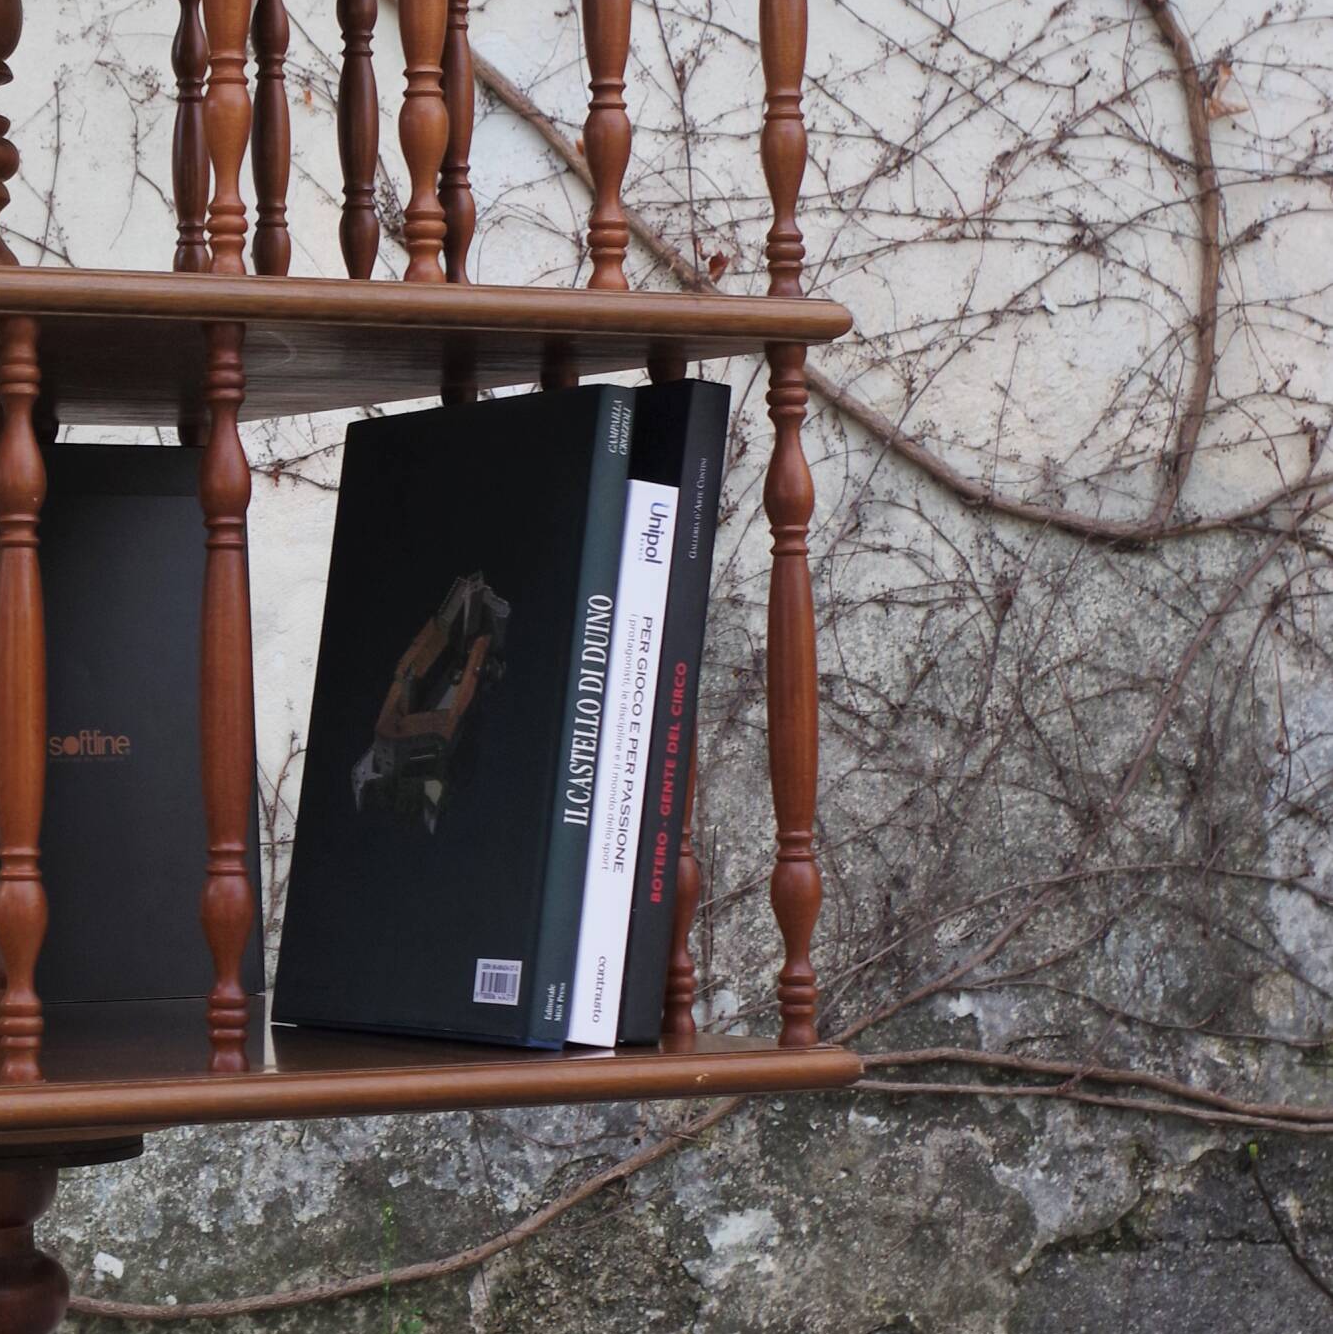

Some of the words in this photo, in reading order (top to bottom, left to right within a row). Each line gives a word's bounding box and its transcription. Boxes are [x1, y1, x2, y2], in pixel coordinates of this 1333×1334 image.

[641, 502, 671, 565] Unipol
[582, 594, 614, 665] DUINO
[638, 615, 654, 653] PER
[621, 619, 637, 687] protagonisti,
[578, 667, 605, 695] DI
[621, 690, 631, 700] le
[631, 657, 648, 717] GIOCO
[671, 662, 687, 716] CIRCO
[49, 729, 131, 756] softline
[615, 702, 629, 752] discipline
[629, 721, 641, 734] E
[666, 722, 682, 755] DEL
[566, 698, 602, 804] CASTELLO
[626, 737, 639, 774] PER
[608, 772, 620, 811] mondo
[660, 759, 677, 816] GENTE
[563, 805, 590, 826] IL
[605, 813, 617, 840] dello
[612, 780, 635, 874] PASSIONE
[601, 842, 612, 871] sport
[650, 832, 669, 903] BOTERO
[592, 955, 607, 1024] contrasto
